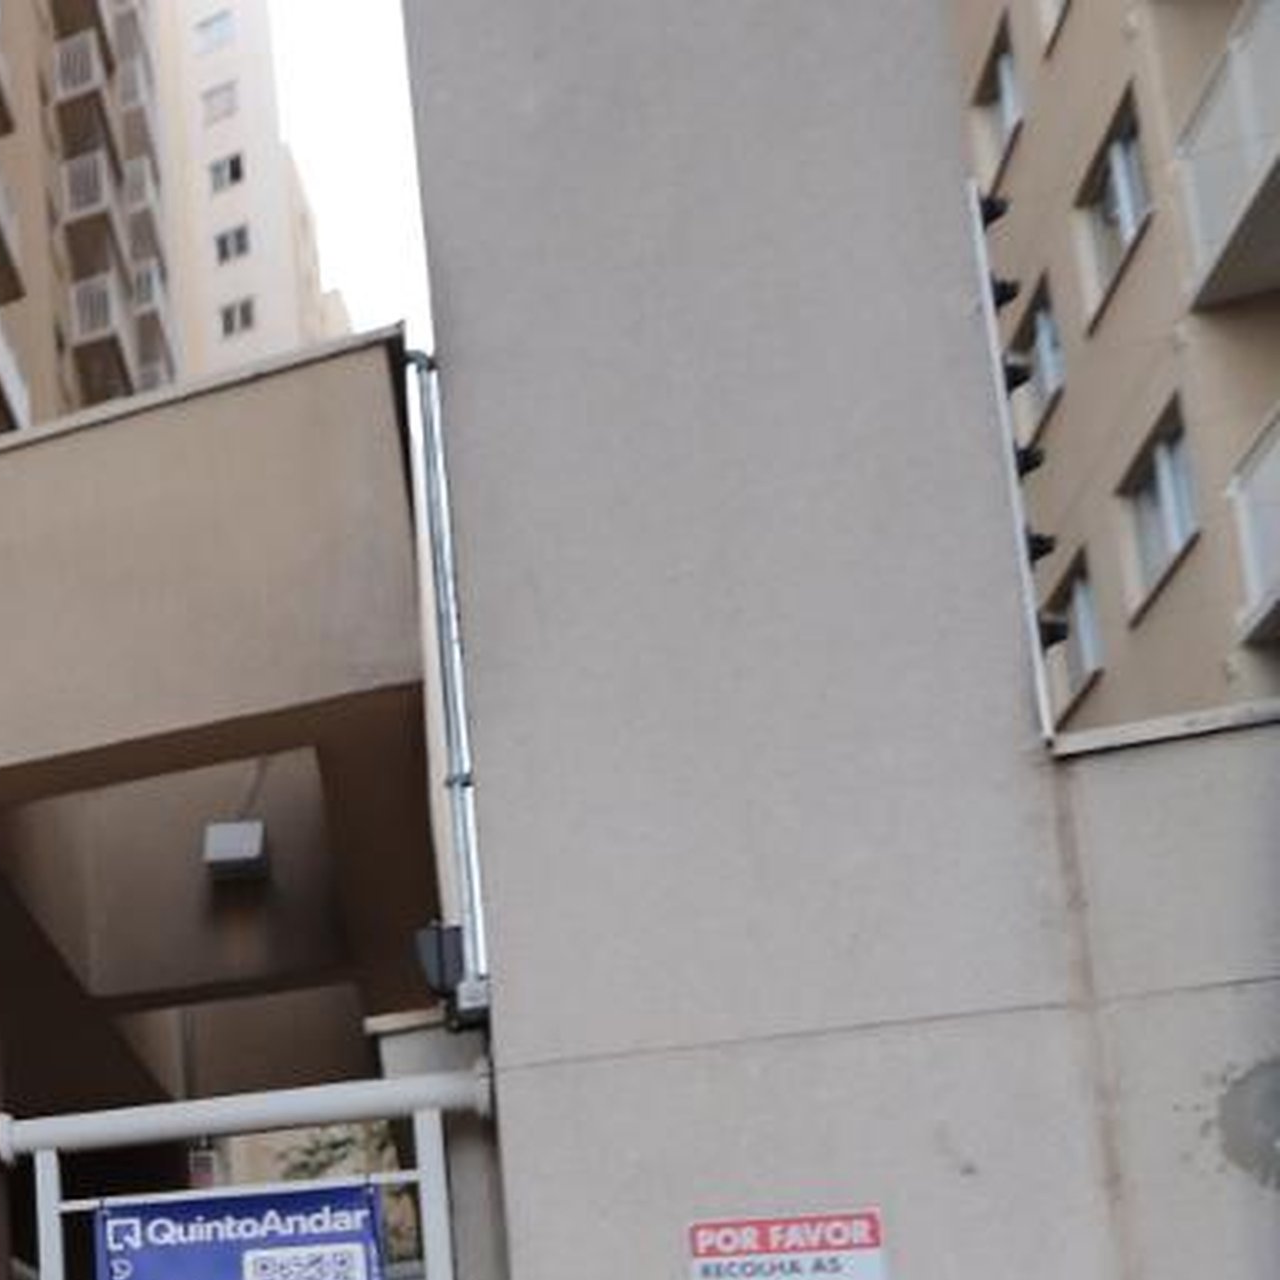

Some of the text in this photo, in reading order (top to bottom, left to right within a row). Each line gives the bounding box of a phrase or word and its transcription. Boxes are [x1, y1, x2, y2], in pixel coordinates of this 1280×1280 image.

[147, 1206, 370, 1245] QuintoAndar
[696, 1218, 870, 1254] POR FAVOR
[811, 1257, 843, 1274] AS
